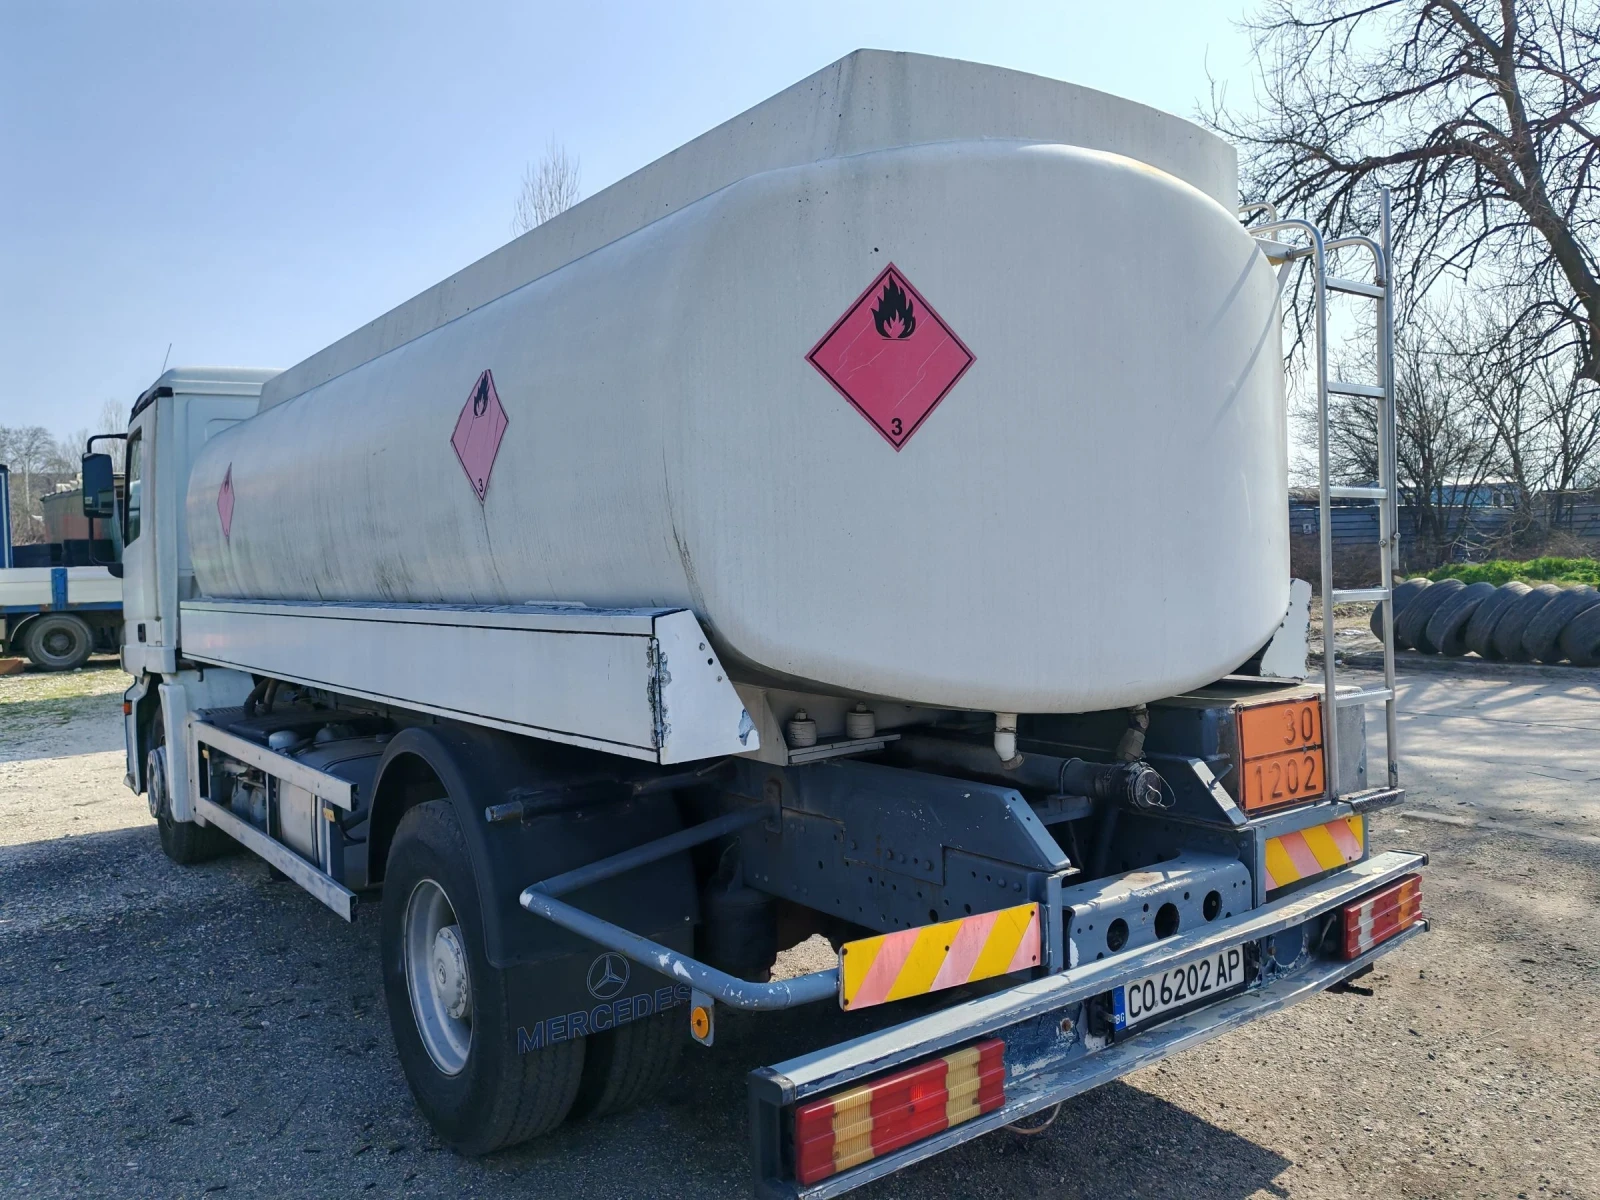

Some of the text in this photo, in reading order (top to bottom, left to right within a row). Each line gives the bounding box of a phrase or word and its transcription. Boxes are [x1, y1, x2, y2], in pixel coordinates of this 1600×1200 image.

[891, 417, 903, 436] 3
[477, 477, 484, 493] 3
[1283, 706, 1313, 745] 30
[1255, 755, 1317, 803] 1202
[1128, 949, 1240, 1018] CO 6202 AP
[517, 982, 692, 1055] MERCEDES
[1115, 1012, 1125, 1025] BG
